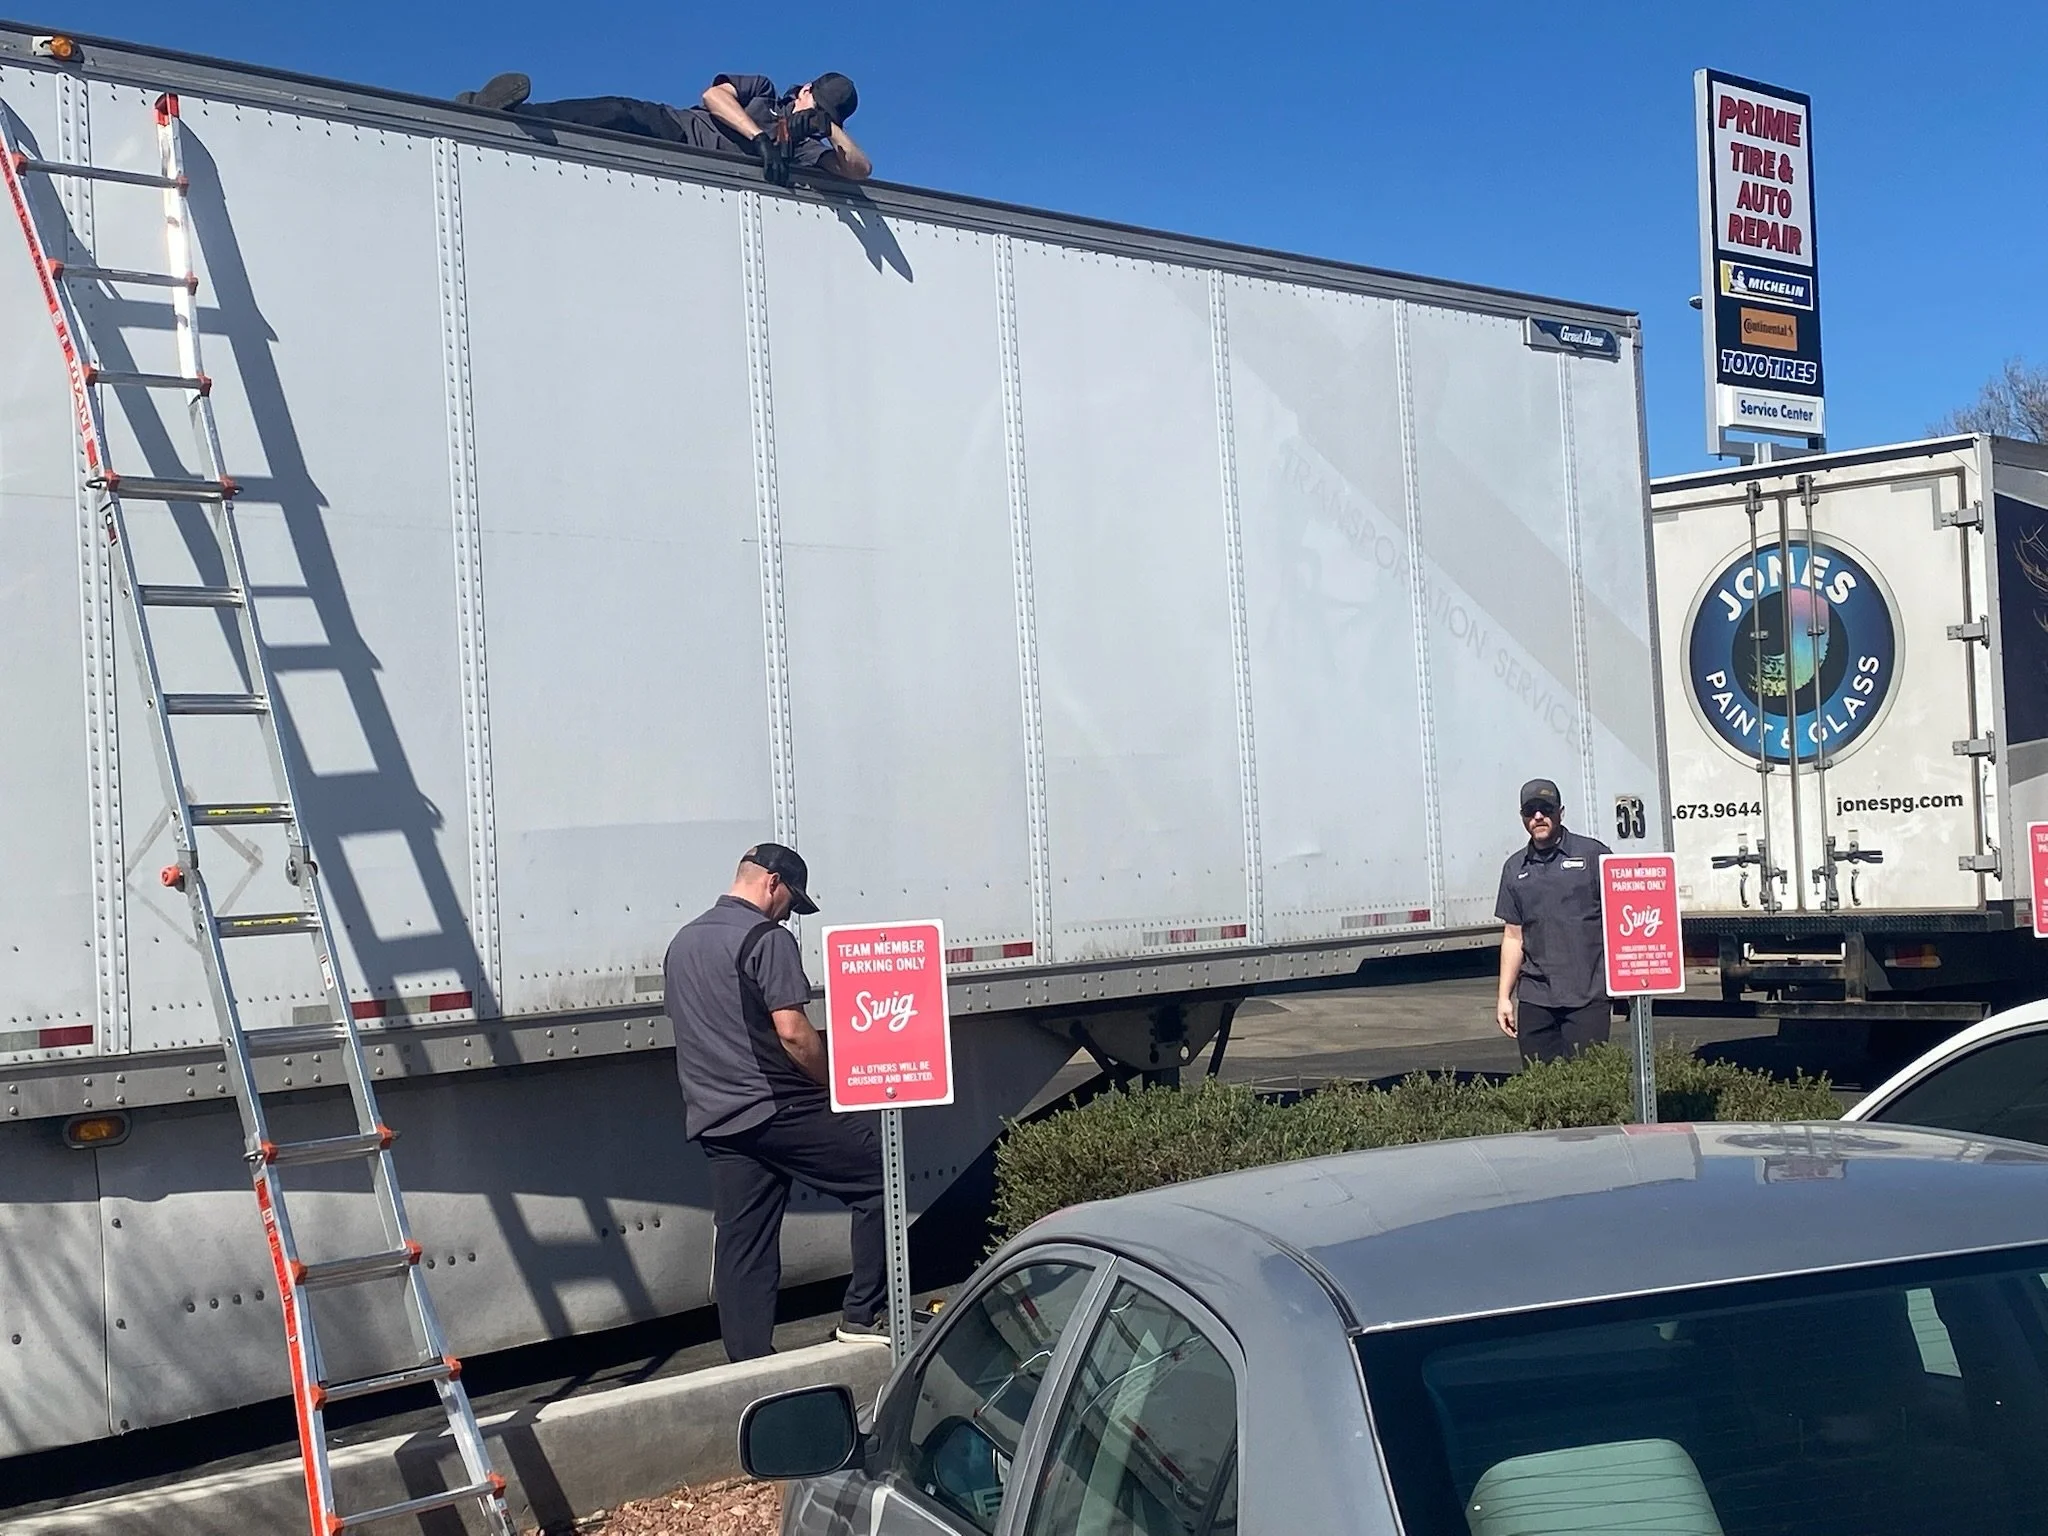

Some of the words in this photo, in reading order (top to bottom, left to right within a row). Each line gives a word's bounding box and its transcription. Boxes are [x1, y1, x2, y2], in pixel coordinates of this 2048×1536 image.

[1718, 94, 1802, 147] PRIME
[1730, 141, 1776, 180] TIRE
[1778, 153, 1794, 184] &
[1737, 180, 1792, 219] AUTO
[1728, 213, 1802, 256] REPAIR
[1748, 277, 1804, 298] MICHELIN
[1583, 329, 1604, 347] Dane
[1743, 318, 1788, 336] Continental
[1740, 399, 1778, 418] Service
[1780, 405, 1814, 422] Center
[1718, 552, 1857, 621] JONES
[1808, 655, 1879, 744] GLASS
[1837, 793, 1964, 816] jonespg.com
[1616, 797, 1645, 839] 53
[1610, 868, 1633, 879] TEAM
[1634, 866, 1667, 878] MEMBER
[1612, 881, 1646, 892] PARKING
[1647, 879, 1666, 891] ONLY
[1619, 904, 1663, 937] Swig
[837, 943, 871, 958] TEAM
[874, 940, 925, 956] MEMBER
[841, 958, 893, 974] PARKING
[896, 957, 926, 972] ONLY
[851, 990, 919, 1033] Swig
[847, 1075, 883, 1087] CRUSHED
[885, 1073, 901, 1084] AND
[902, 1071, 935, 1083] MELTED.
[851, 1064, 866, 1075] ALL
[867, 1063, 897, 1074] OTHERS
[898, 1061, 918, 1072] WILL
[919, 1060, 930, 1070] BE
